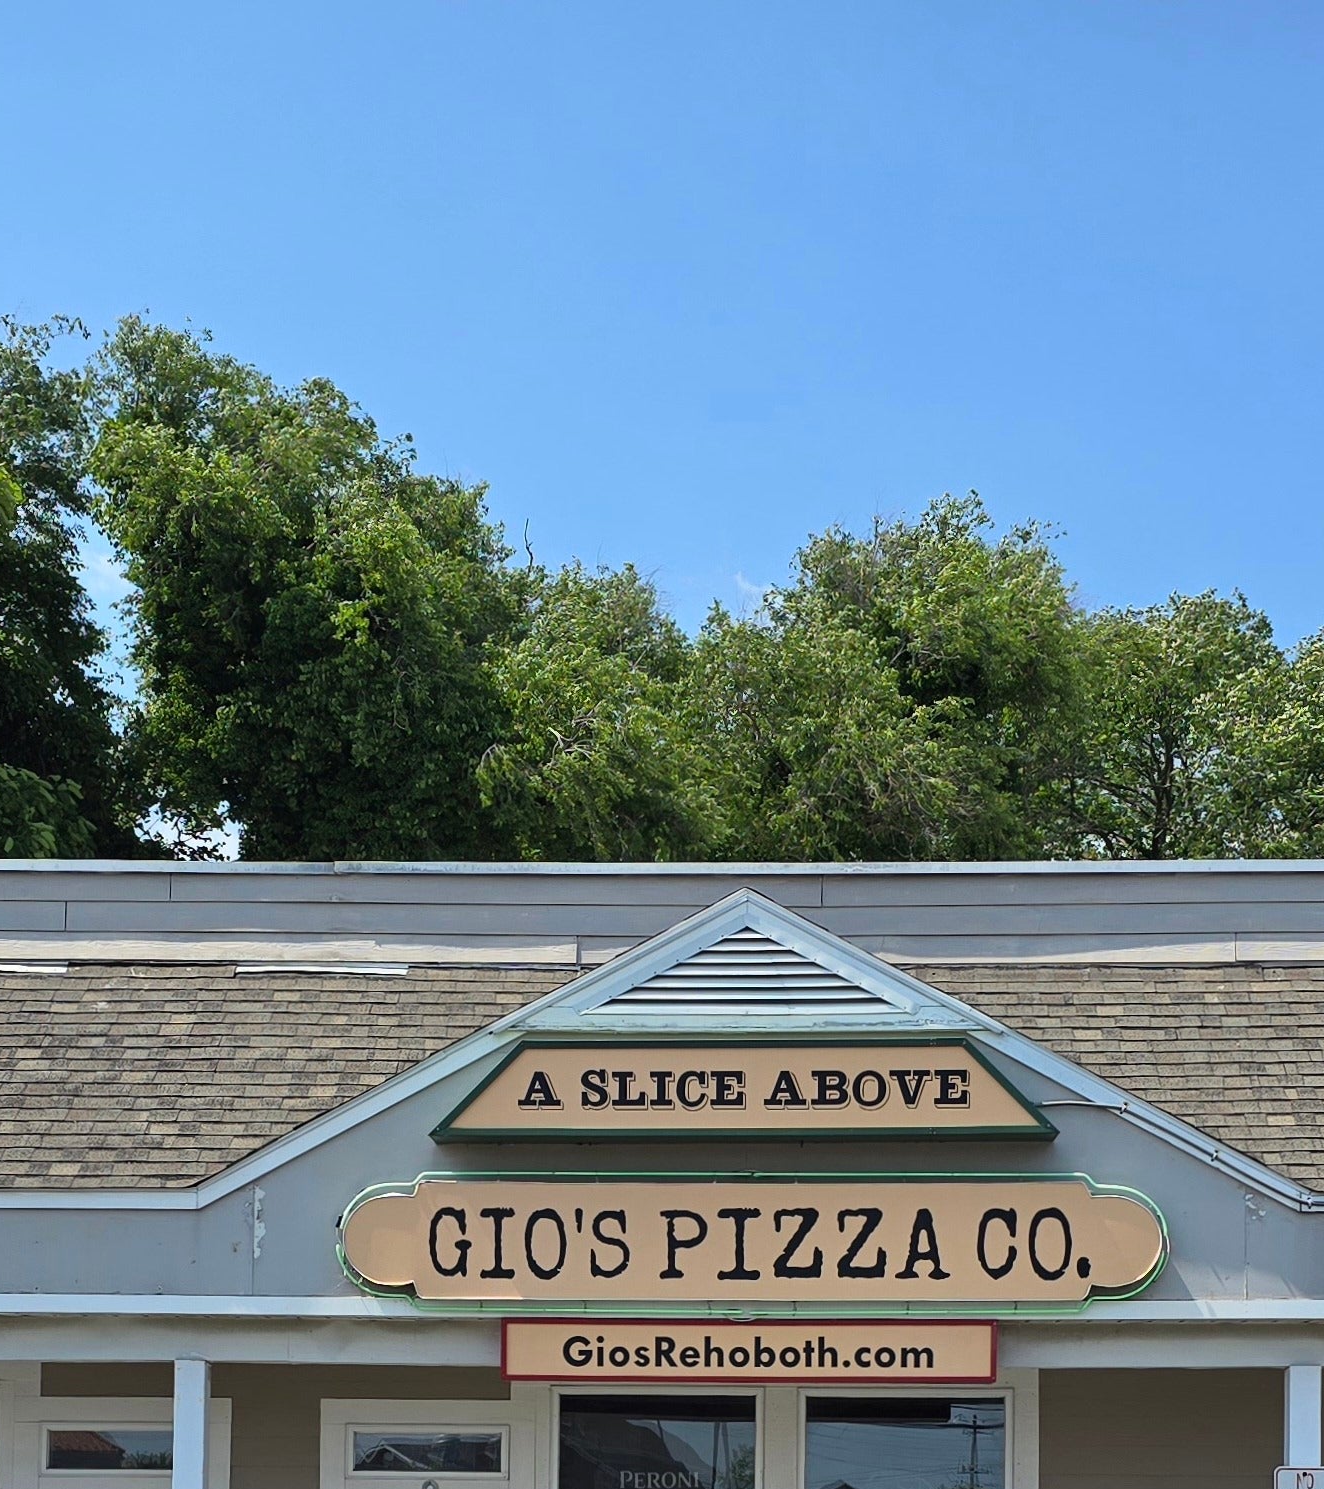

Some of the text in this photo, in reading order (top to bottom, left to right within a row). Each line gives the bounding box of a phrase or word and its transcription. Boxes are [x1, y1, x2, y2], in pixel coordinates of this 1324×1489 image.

[518, 1069, 972, 1111] A SLICE ABOVE
[429, 1207, 1091, 1280] GIO'S PIZZA CO.
[562, 1335, 934, 1369] GiosRehoboth.com
[1296, 1472, 1314, 1489] NO
